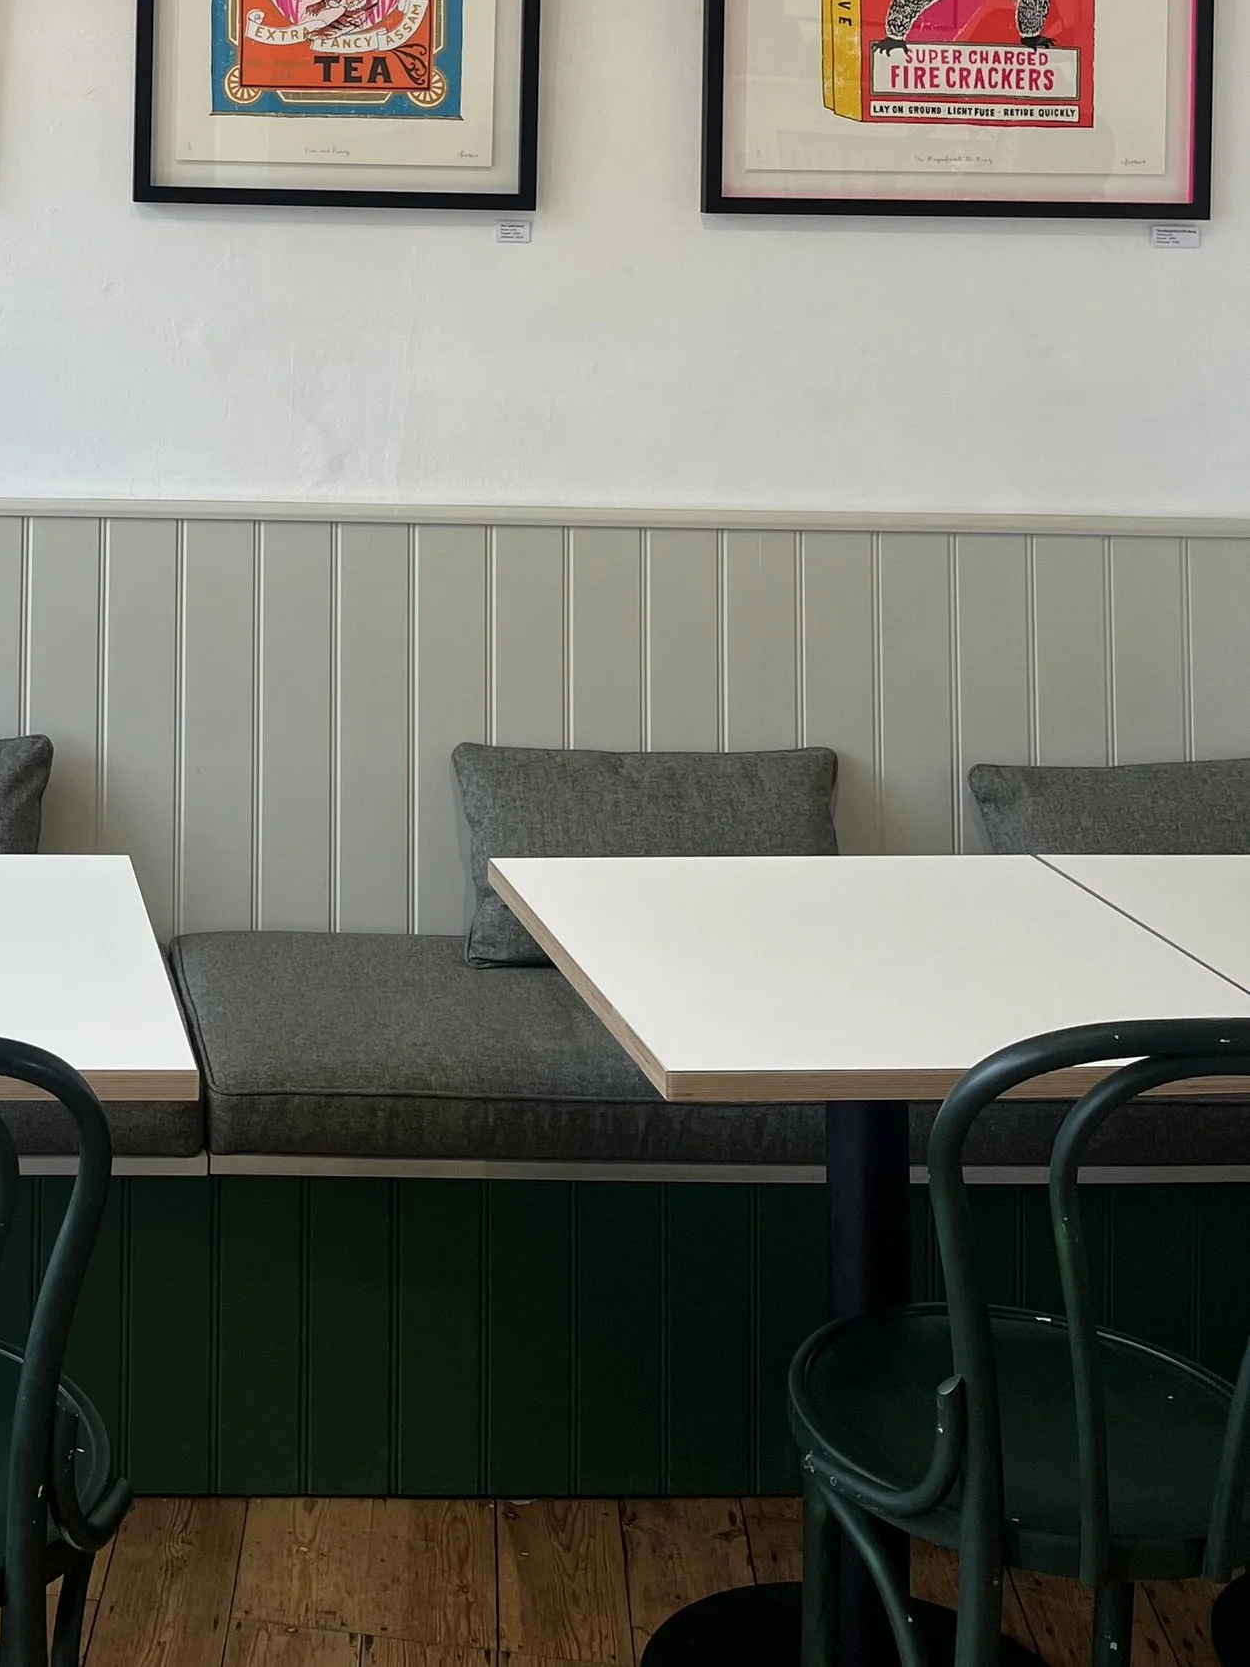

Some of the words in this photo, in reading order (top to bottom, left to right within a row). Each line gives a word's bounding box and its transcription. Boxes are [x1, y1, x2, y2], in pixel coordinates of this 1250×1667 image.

[255, 26, 310, 41] EXTRA
[320, 37, 372, 49] FANCY
[385, 4, 422, 46] ASSAM
[314, 55, 393, 84] TEA
[905, 49, 962, 65] SUPER
[968, 50, 1048, 66] CHARGED
[890, 65, 940, 90] FIRE
[945, 67, 1055, 91] CRACKERS
[873, 105, 890, 114] LAY
[892, 106, 903, 114] ON
[908, 106, 942, 115] GROUND
[947, 107, 974, 116] LIGHT
[974, 108, 995, 117] FUSE
[1003, 108, 1035, 117] RETIRE
[1038, 108, 1076, 118] QUICKLY
